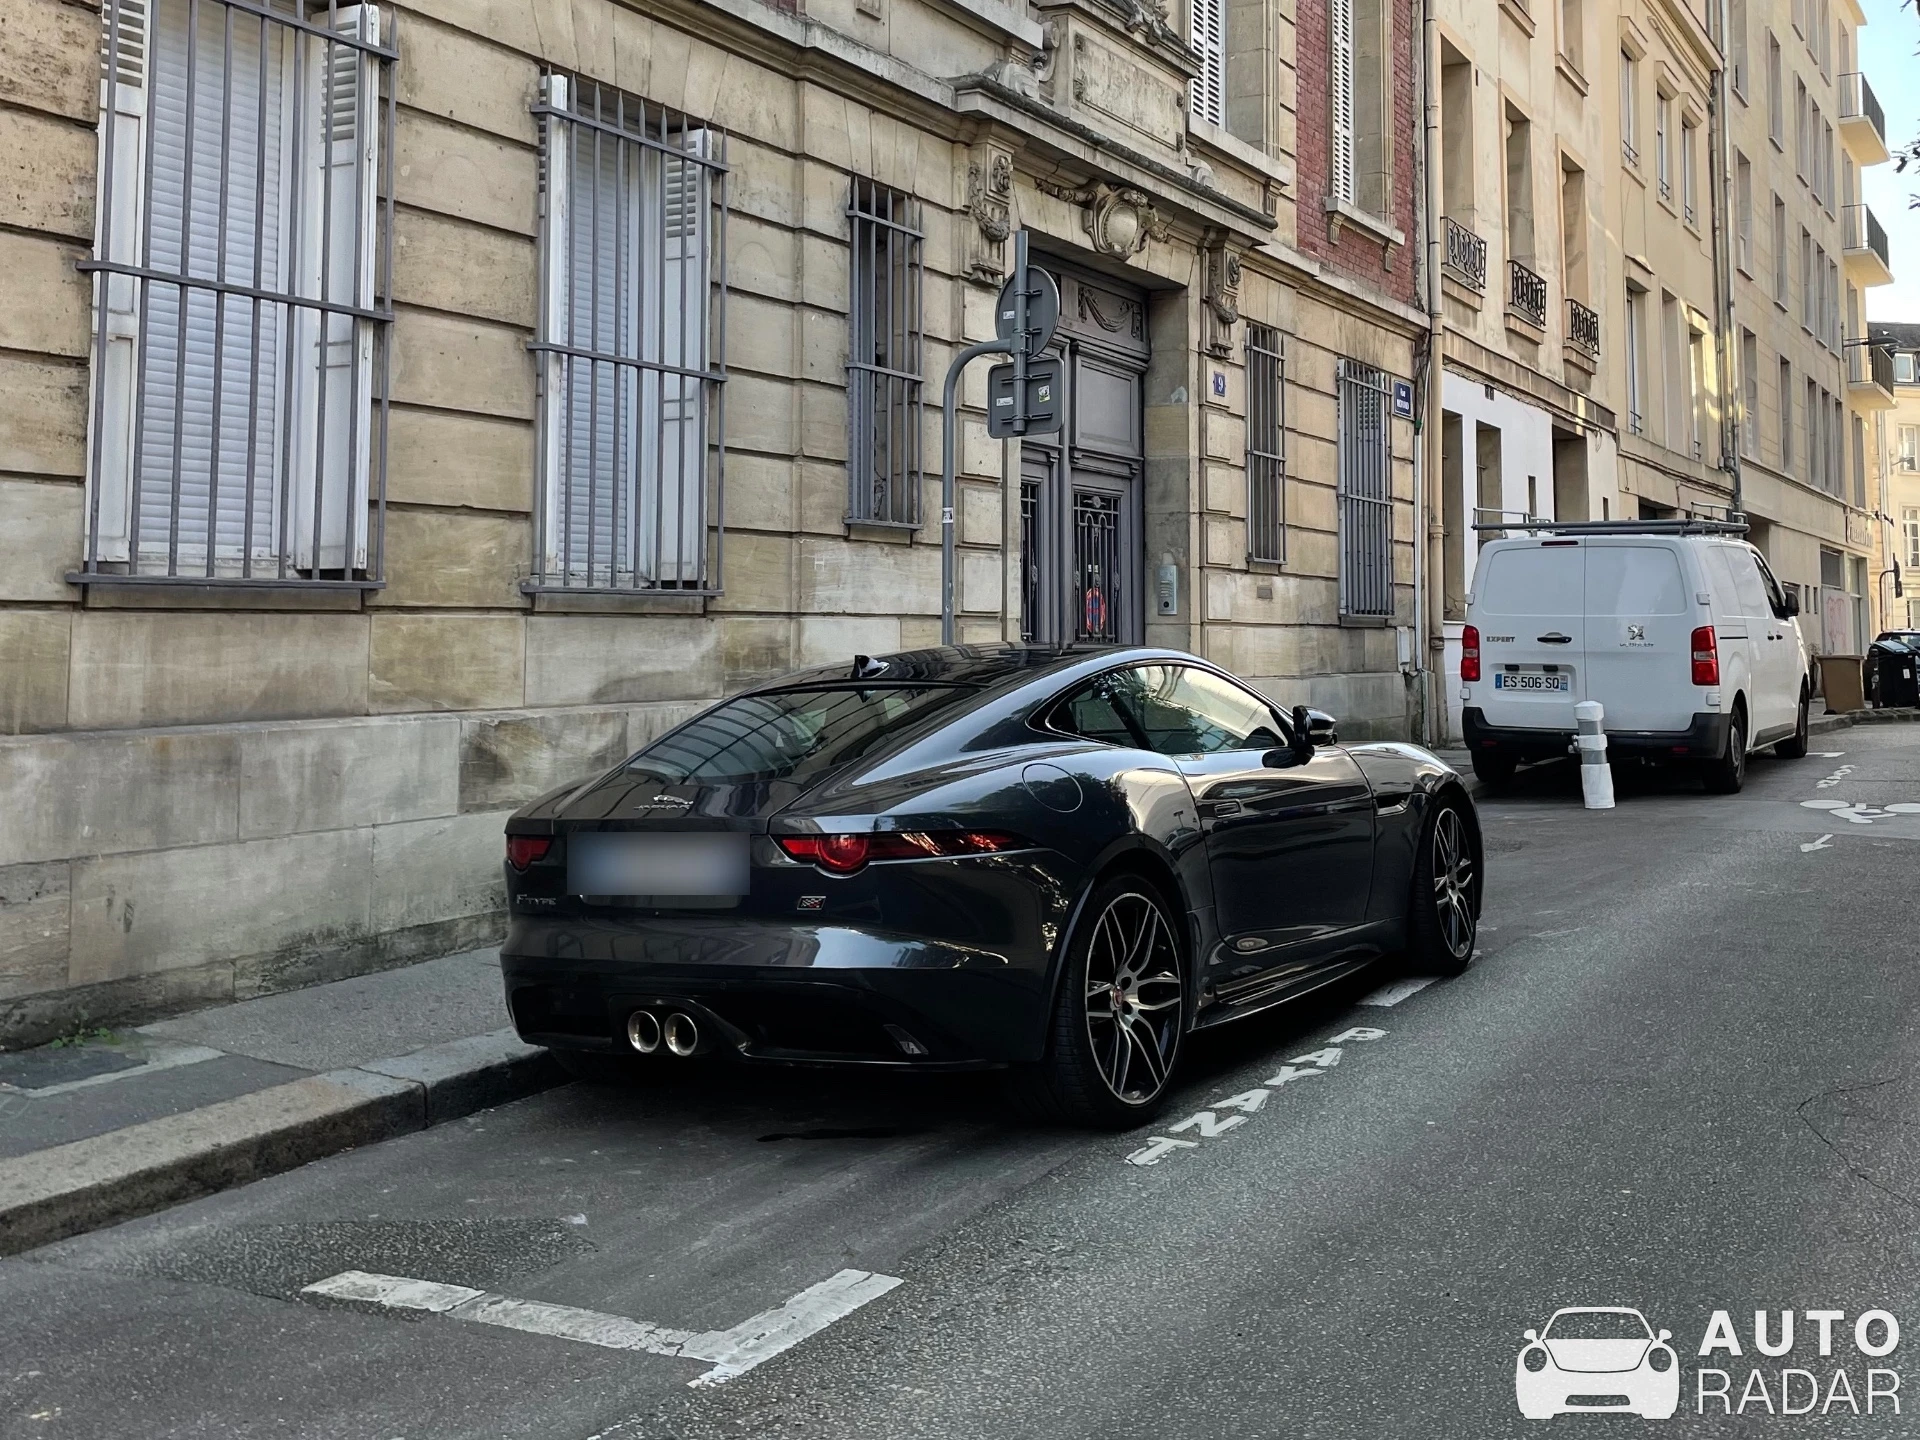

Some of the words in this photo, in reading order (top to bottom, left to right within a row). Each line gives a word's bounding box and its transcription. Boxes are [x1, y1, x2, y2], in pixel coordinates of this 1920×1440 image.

[1218, 376, 1224, 392] 9
[1503, 675, 1560, 689] ES-506-SQ
[1124, 1026, 1391, 1166] PAYANT
